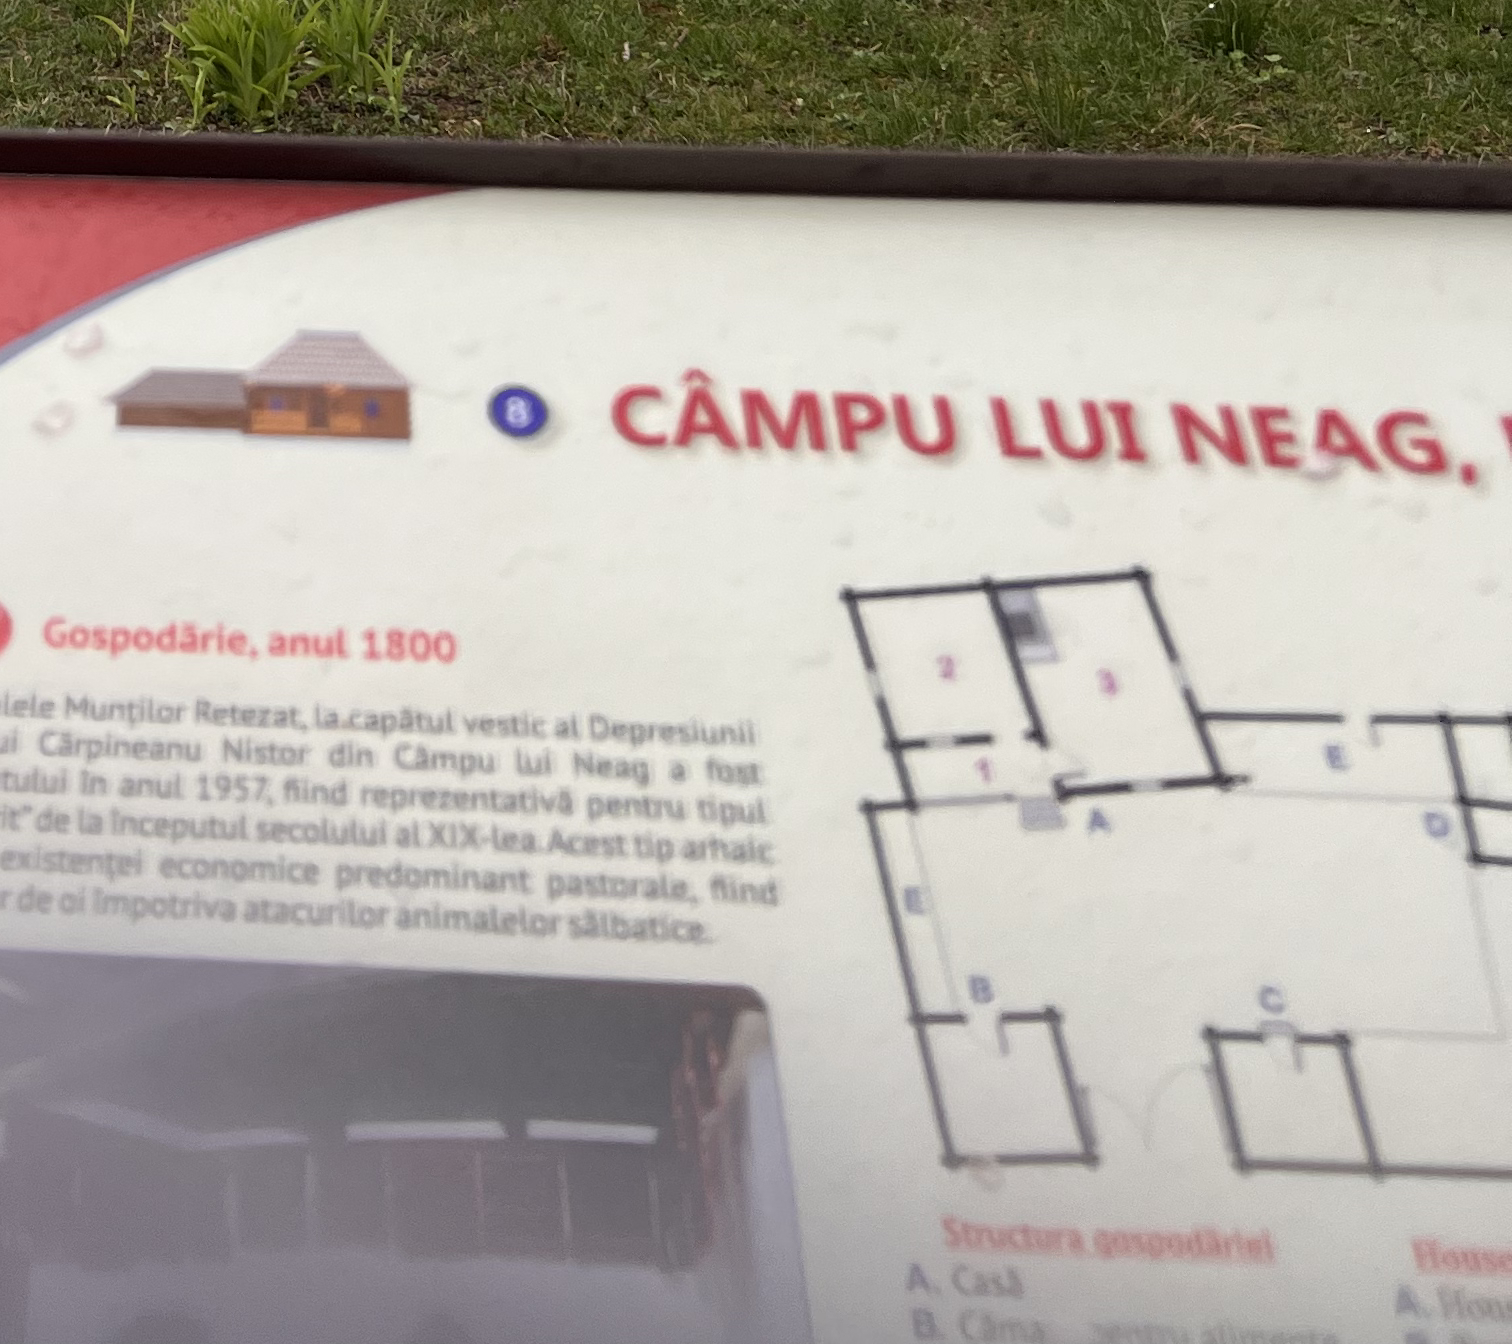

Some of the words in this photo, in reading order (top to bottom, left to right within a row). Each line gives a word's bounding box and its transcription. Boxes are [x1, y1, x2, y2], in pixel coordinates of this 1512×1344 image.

[610, 367, 958, 457] CÂMPU
[988, 395, 1148, 463] LUI
[1169, 401, 1479, 487] NEAG,
[43, 615, 260, 662] Gospodărie,
[268, 628, 348, 660] anul
[364, 628, 457, 664] 1800
[314, 702, 339, 731] la
[462, 710, 548, 741] vestic
[553, 713, 579, 741] al
[590, 712, 757, 747] Depresiunii
[221, 736, 311, 768] Nistor
[327, 738, 375, 769] din
[514, 746, 553, 776] lui
[573, 749, 651, 787] Neag
[669, 759, 687, 782] a
[706, 755, 762, 787] fost
[974, 756, 993, 784] 1
[80, 767, 109, 798] în
[118, 770, 182, 800] anul
[282, 777, 349, 808] fiind
[588, 793, 687, 822] pentru
[697, 794, 768, 828] tipul
[1089, 807, 1112, 835] A
[34, 806, 72, 835] de
[78, 806, 104, 837] la
[256, 816, 387, 848] secolului
[396, 819, 421, 850] al
[547, 827, 628, 858] Acest
[633, 831, 675, 865] tip
[159, 853, 321, 887] economice
[334, 861, 531, 894] predominant
[15, 883, 54, 915] de
[57, 887, 86, 917] oi
[243, 894, 387, 930] atacurilor
[395, 903, 559, 939] animalelor
[1257, 985, 1286, 1013] C
